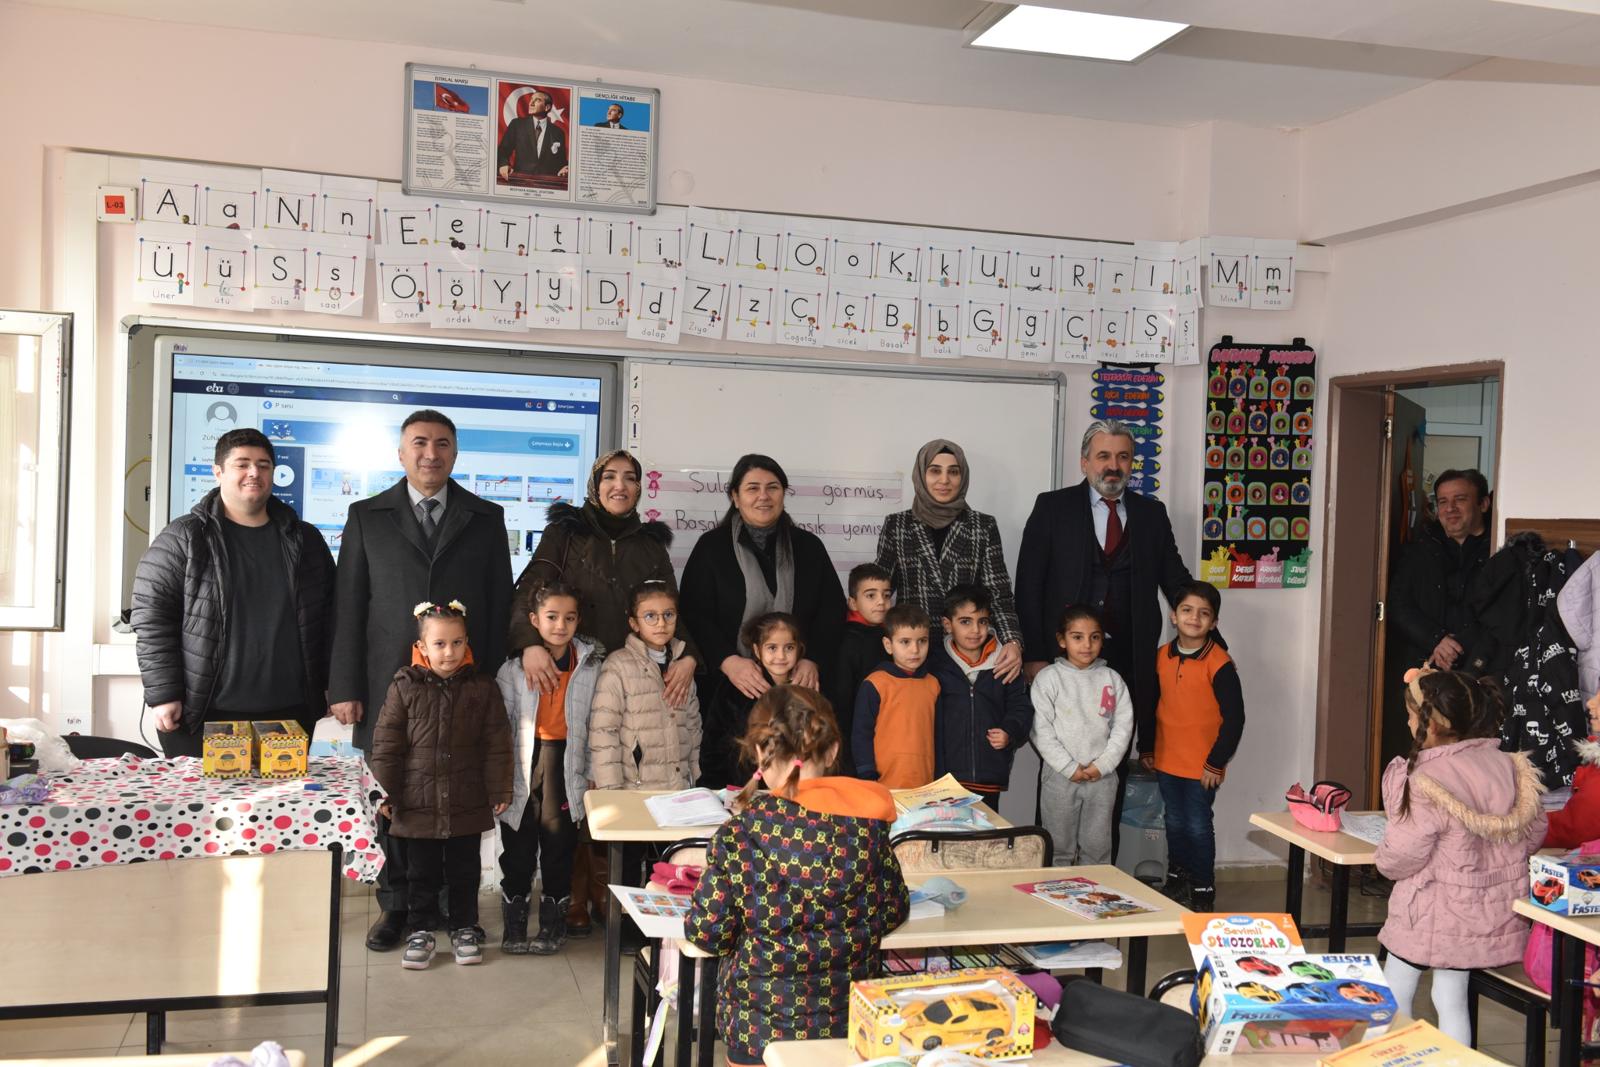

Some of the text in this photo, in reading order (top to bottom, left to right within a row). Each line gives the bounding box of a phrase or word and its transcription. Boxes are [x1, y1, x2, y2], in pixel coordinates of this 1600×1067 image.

[106, 201, 125, 210] L-03
[156, 188, 180, 217] A
[222, 203, 237, 219] a
[277, 196, 302, 227] N
[341, 212, 354, 226] n
[398, 216, 418, 245] E
[450, 219, 464, 234] e
[500, 221, 517, 249] T
[553, 223, 562, 245] t
[701, 232, 717, 261] L
[794, 242, 817, 267] O
[153, 245, 174, 278] Ü
[219, 259, 232, 278] ü
[271, 255, 288, 281] S
[847, 254, 859, 267] o
[889, 250, 905, 276] K
[940, 253, 950, 276] k
[980, 254, 997, 278] U
[1029, 265, 1041, 278] u
[1217, 259, 1239, 284] M
[330, 267, 340, 282] s
[390, 267, 417, 299] Ö
[1073, 264, 1085, 288] R
[1113, 271, 1124, 284] r
[1265, 267, 1282, 281] m
[450, 279, 464, 297] ö
[493, 279, 512, 304] Y
[548, 277, 561, 301] y
[599, 279, 618, 305] D
[693, 286, 712, 312] Z
[648, 291, 663, 315] d
[749, 299, 760, 313] z
[885, 303, 899, 327] B
[544, 316, 560, 324] yay
[938, 309, 949, 333] b
[973, 309, 995, 333] G
[1024, 315, 1037, 337] g
[1066, 315, 1084, 339] C
[1107, 321, 1117, 334] c
[632, 404, 640, 418] ?
[633, 422, 636, 438] !
[1541, 864, 1564, 879] FASTER
[1224, 926, 1262, 936] Sevimli
